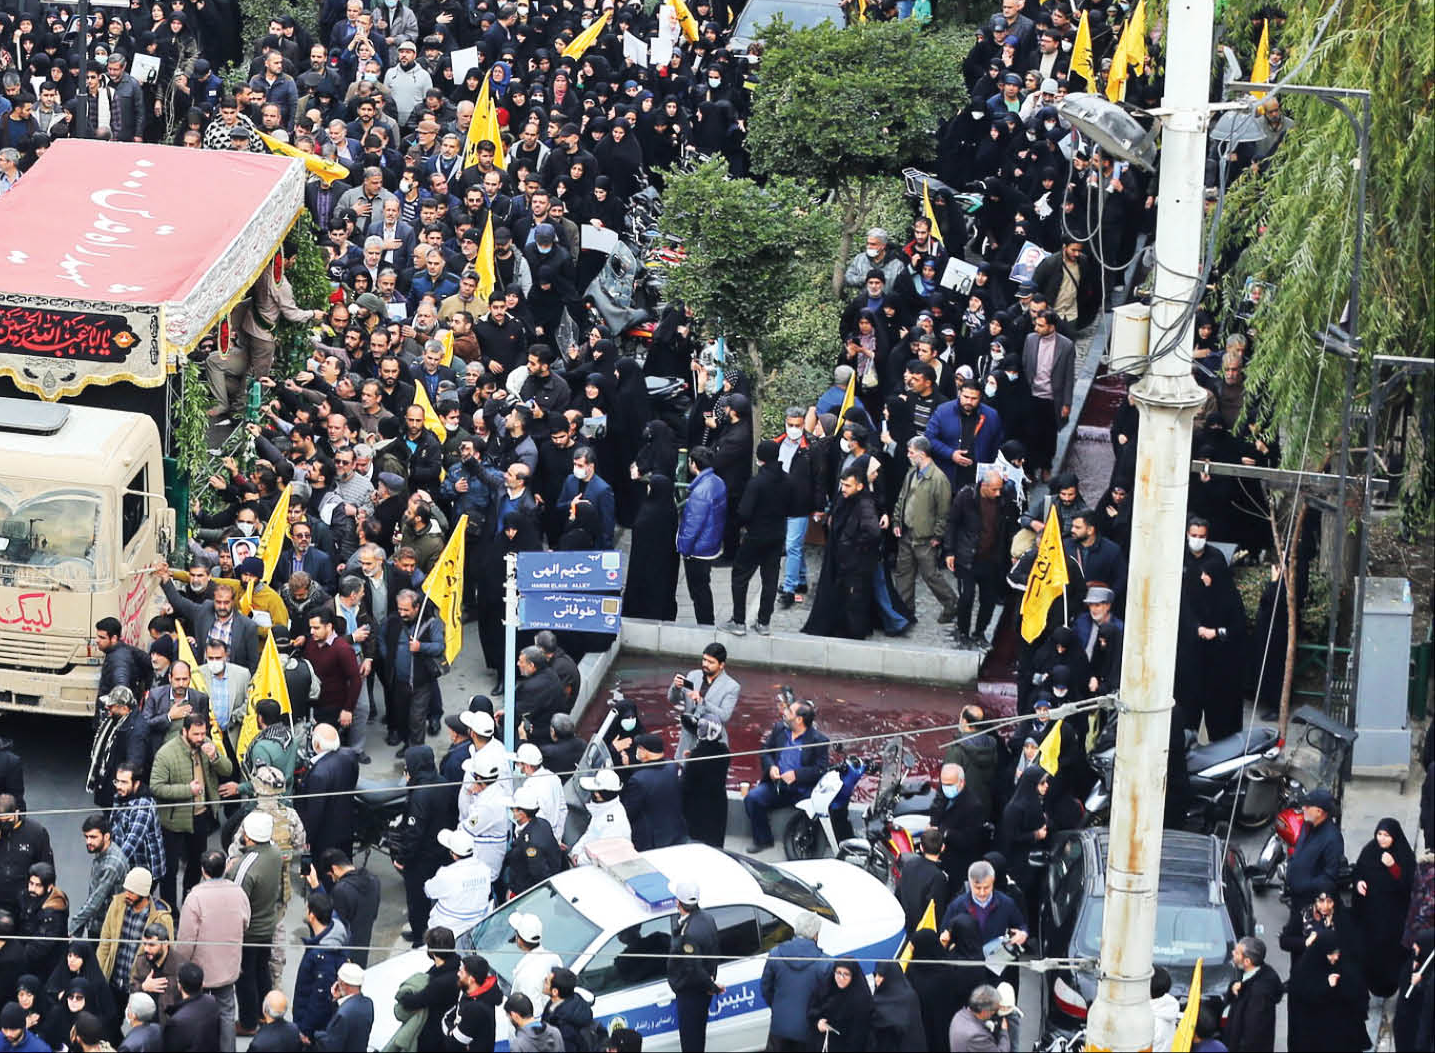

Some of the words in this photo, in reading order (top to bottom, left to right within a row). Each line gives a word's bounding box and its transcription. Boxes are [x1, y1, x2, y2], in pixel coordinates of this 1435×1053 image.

[532, 563, 560, 578] الهی
[560, 563, 592, 579] حکیم
[708, 986, 755, 1017] پلیس
